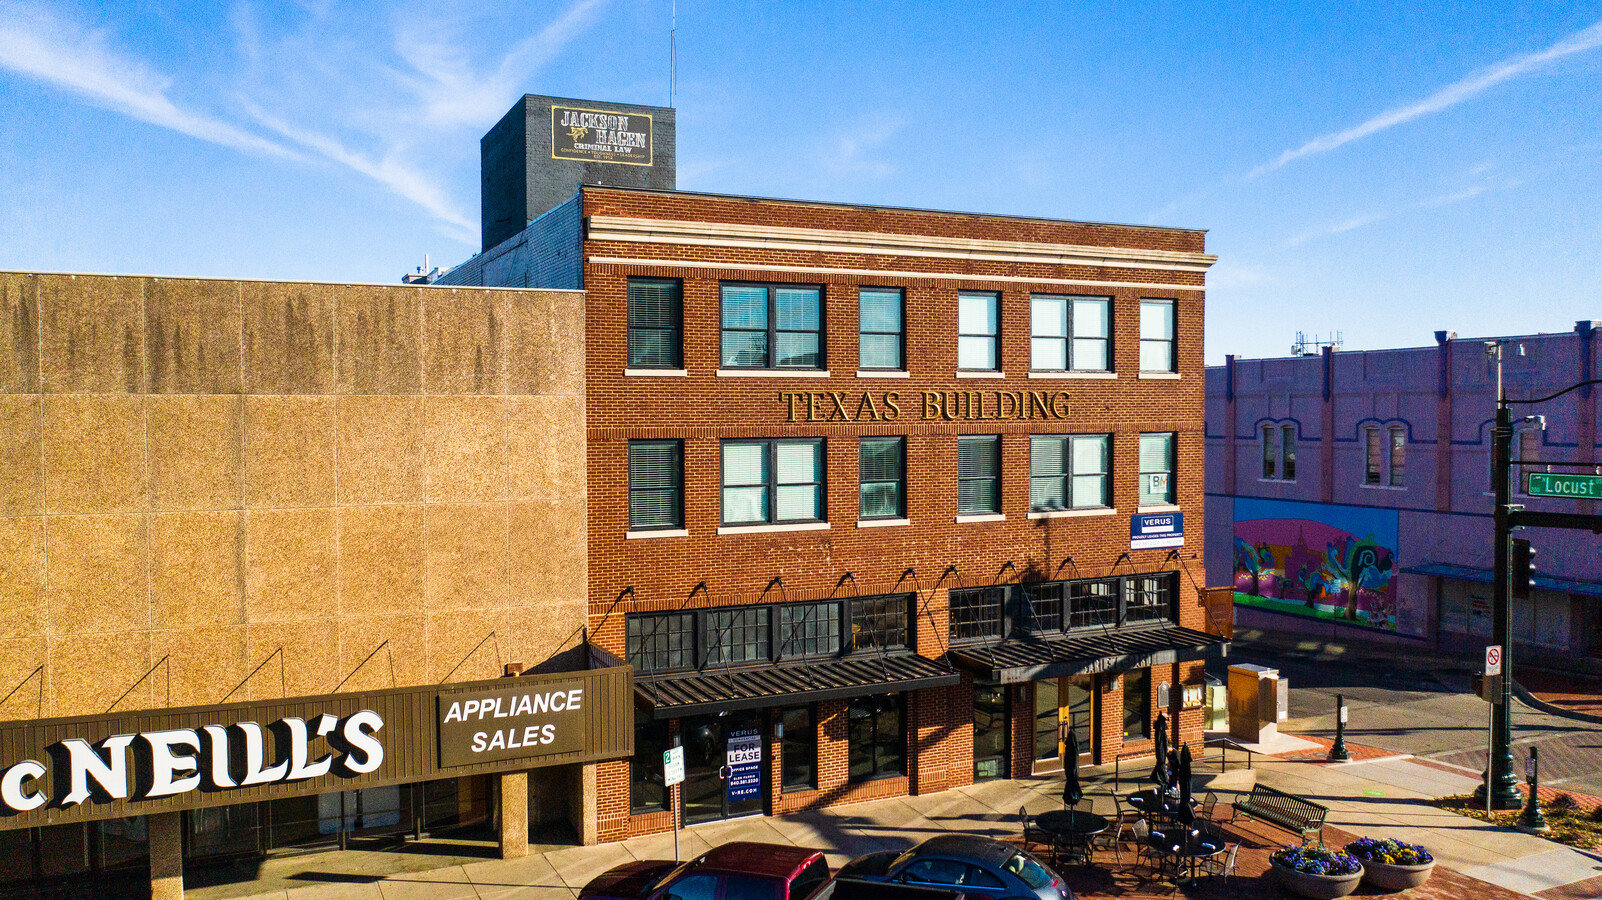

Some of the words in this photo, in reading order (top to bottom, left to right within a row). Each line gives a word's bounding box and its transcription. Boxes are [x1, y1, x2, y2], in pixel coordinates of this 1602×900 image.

[561, 110, 628, 131] JACKSON
[595, 129, 646, 148] HAGEN
[574, 142, 613, 152] CRIMINAL
[614, 145, 632, 153] LAW
[779, 391, 900, 422] TEXAS
[920, 390, 1071, 420] BUILDING
[1545, 476, 1595, 495] Locust
[1144, 518, 1171, 526] VERUS
[444, 689, 582, 723] APPLIANCE
[471, 724, 556, 753] SALES
[731, 729, 758, 737] VERUS
[734, 743, 755, 752] FOR
[665, 753, 670, 763] 2
[730, 751, 760, 762] LEASE
